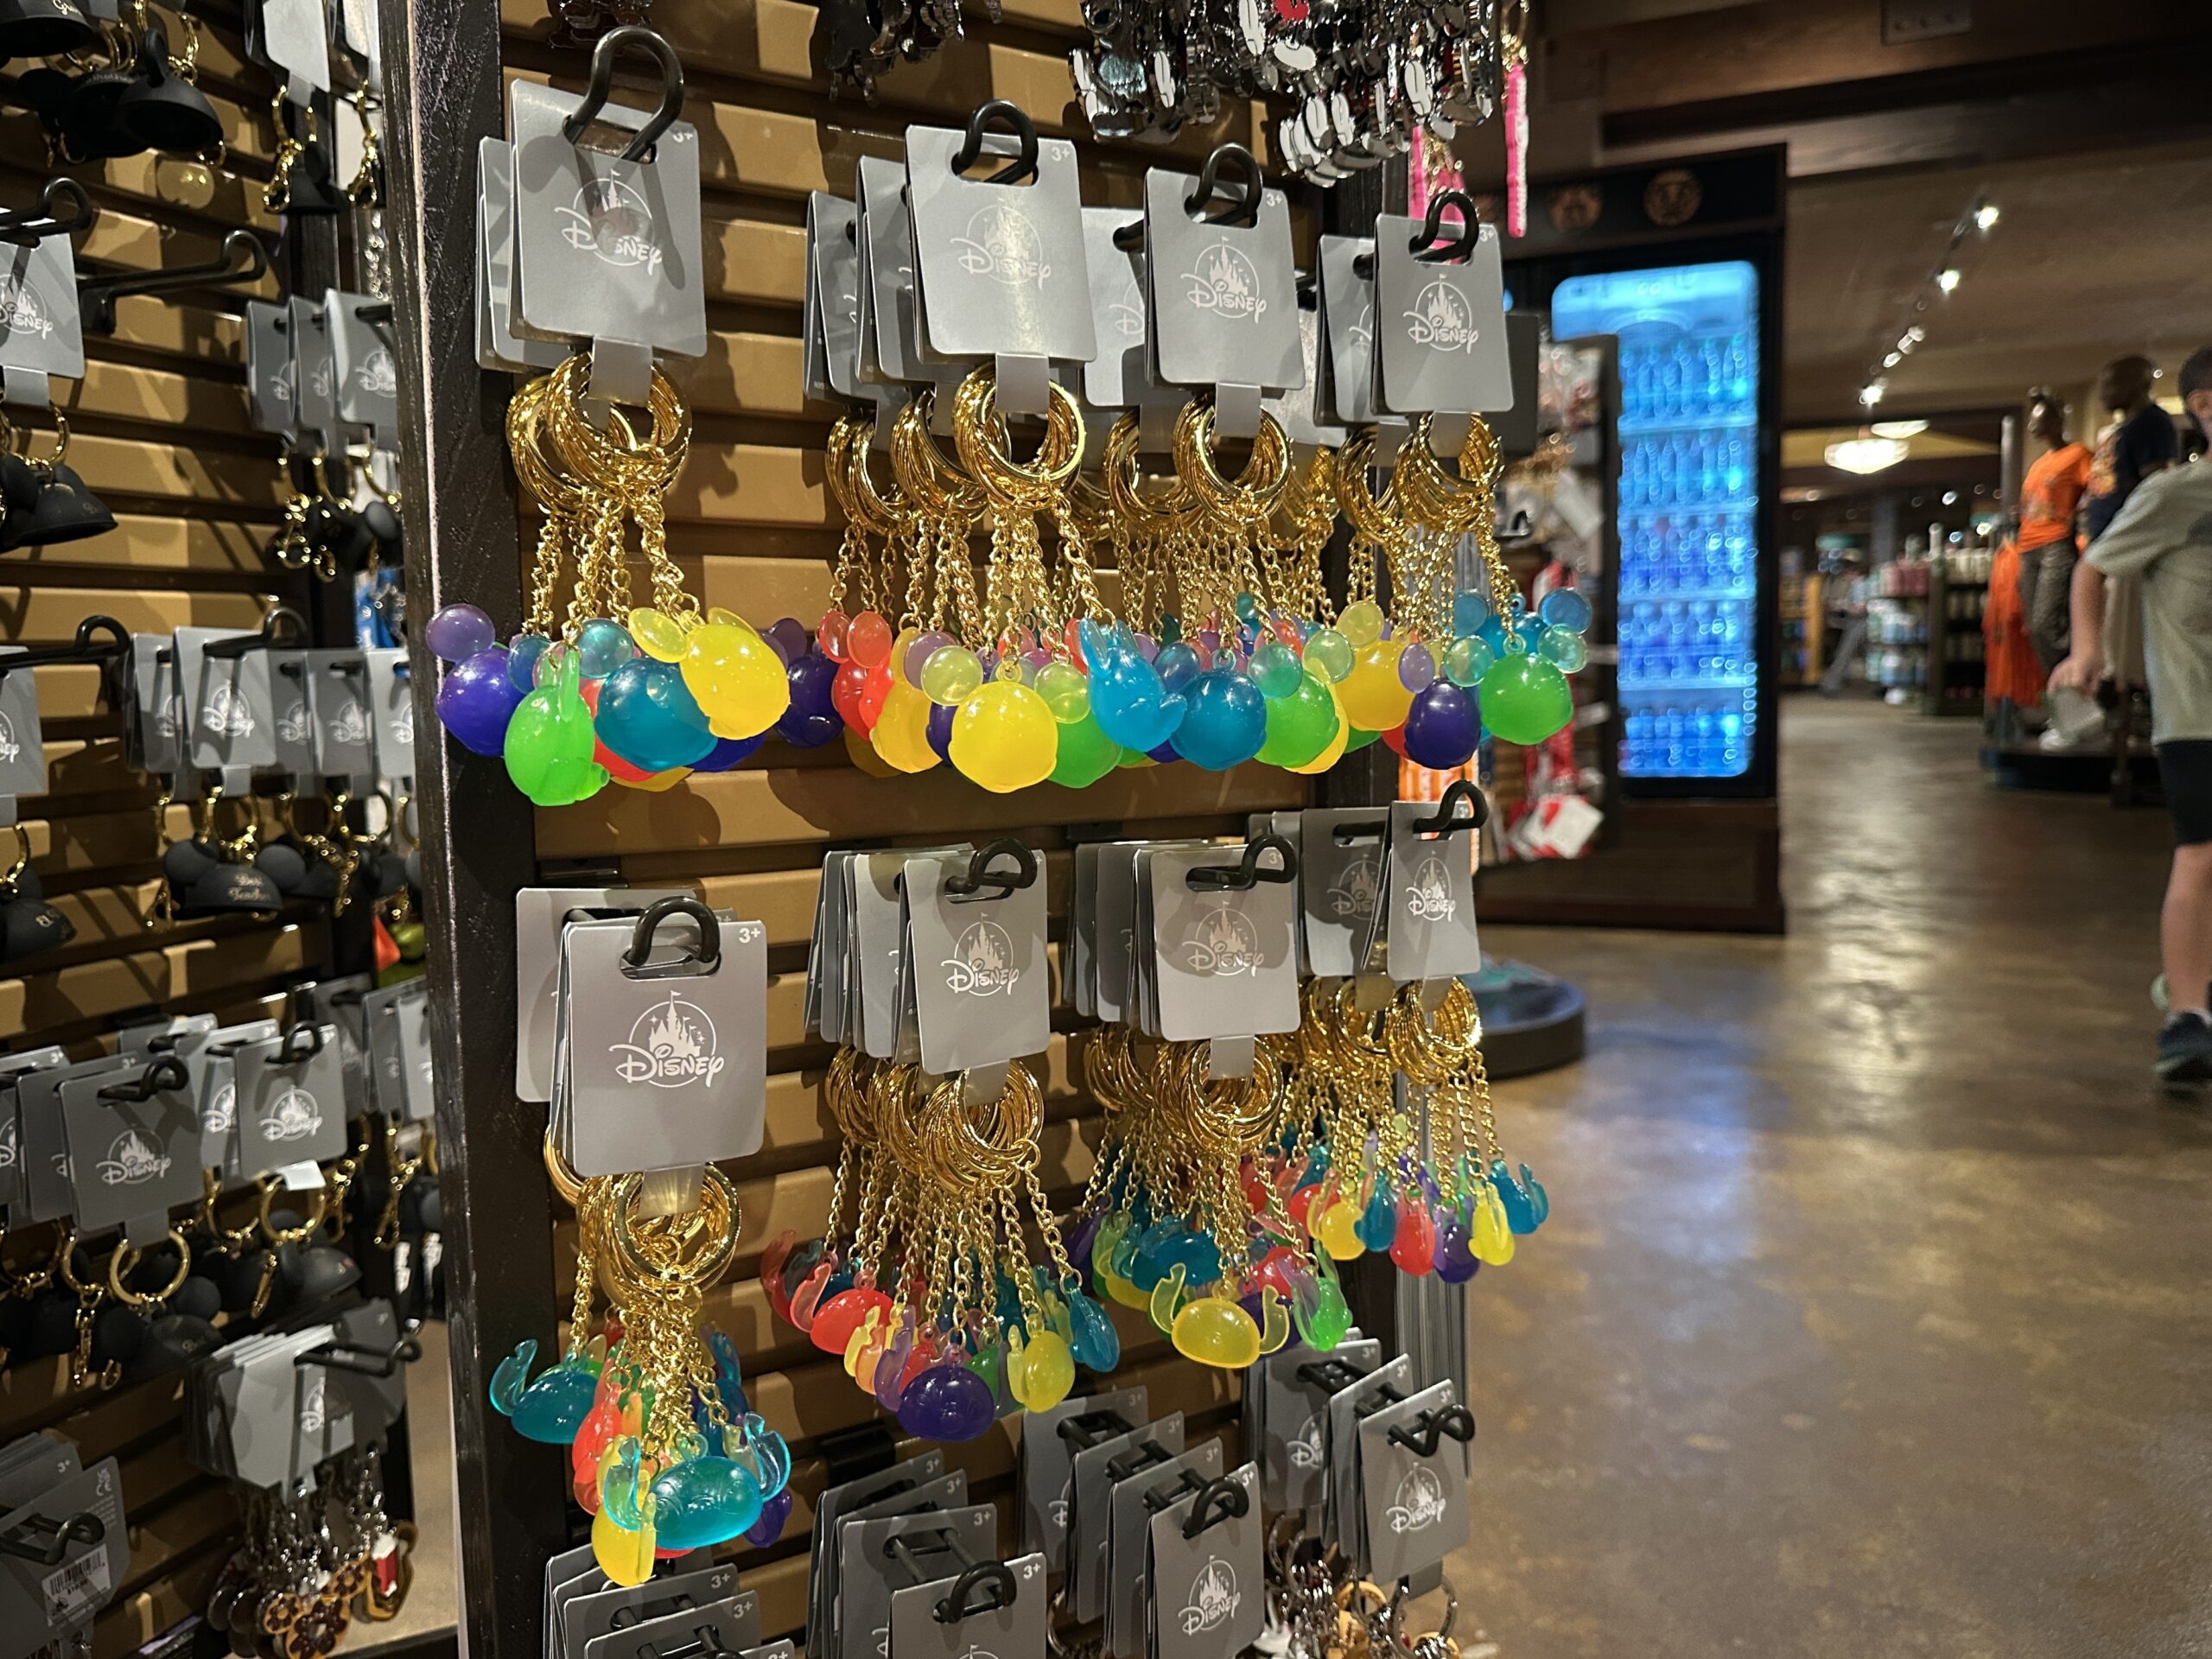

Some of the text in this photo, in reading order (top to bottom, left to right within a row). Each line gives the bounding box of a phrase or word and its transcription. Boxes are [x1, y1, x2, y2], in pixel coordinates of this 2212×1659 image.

[1051, 147, 1070, 162] 3+
[1266, 194, 1282, 207] 3+
[1478, 229, 1494, 242] 3+
[1180, 273, 1267, 324] Disney
[1402, 311, 1479, 354] Disney
[1405, 887, 1457, 922] Disney
[738, 927, 761, 944] 3+
[1182, 940, 1264, 976] Disney
[940, 959, 1020, 995] Disney
[609, 1044, 724, 1088] Disney
[96, 1157, 172, 1185] Disney
[1205, 1447, 1219, 1462] 3+
[925, 1458, 940, 1473] 3+
[946, 1476, 962, 1493] 3+
[973, 1510, 991, 1527] 3+
[1386, 1497, 1447, 1535] Disney
[1023, 1561, 1042, 1580] 3+
[710, 1573, 731, 1589] 3+
[733, 1600, 753, 1619] 3+
[1178, 1592, 1241, 1637] Disney
